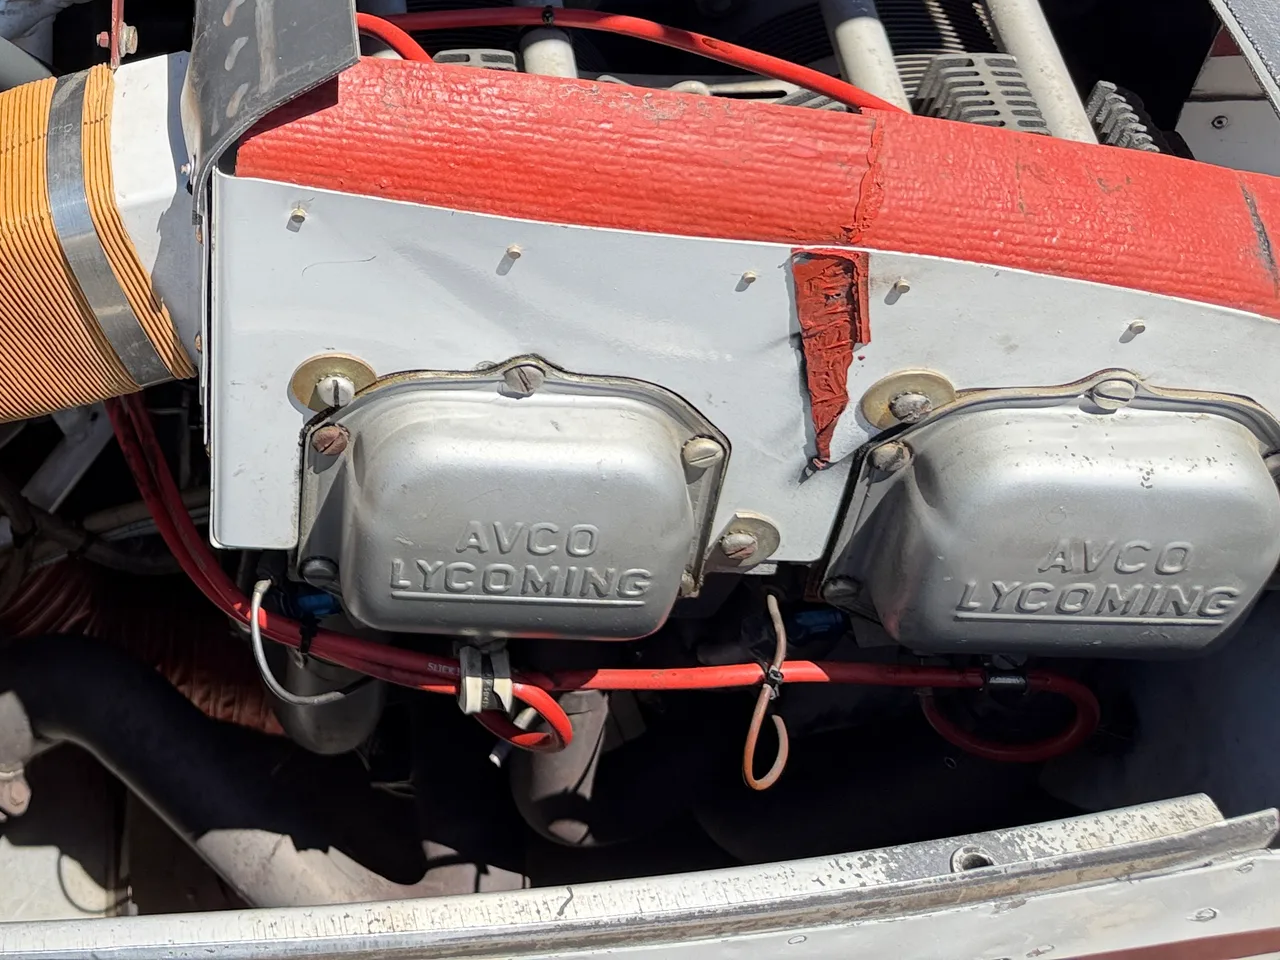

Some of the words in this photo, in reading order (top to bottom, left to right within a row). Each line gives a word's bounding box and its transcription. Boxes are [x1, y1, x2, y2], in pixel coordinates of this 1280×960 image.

[455, 520, 600, 557] AVCO
[1037, 539, 1195, 575] AVCO
[390, 557, 654, 597] LYCOMING
[955, 579, 1241, 617] LYCOMING
